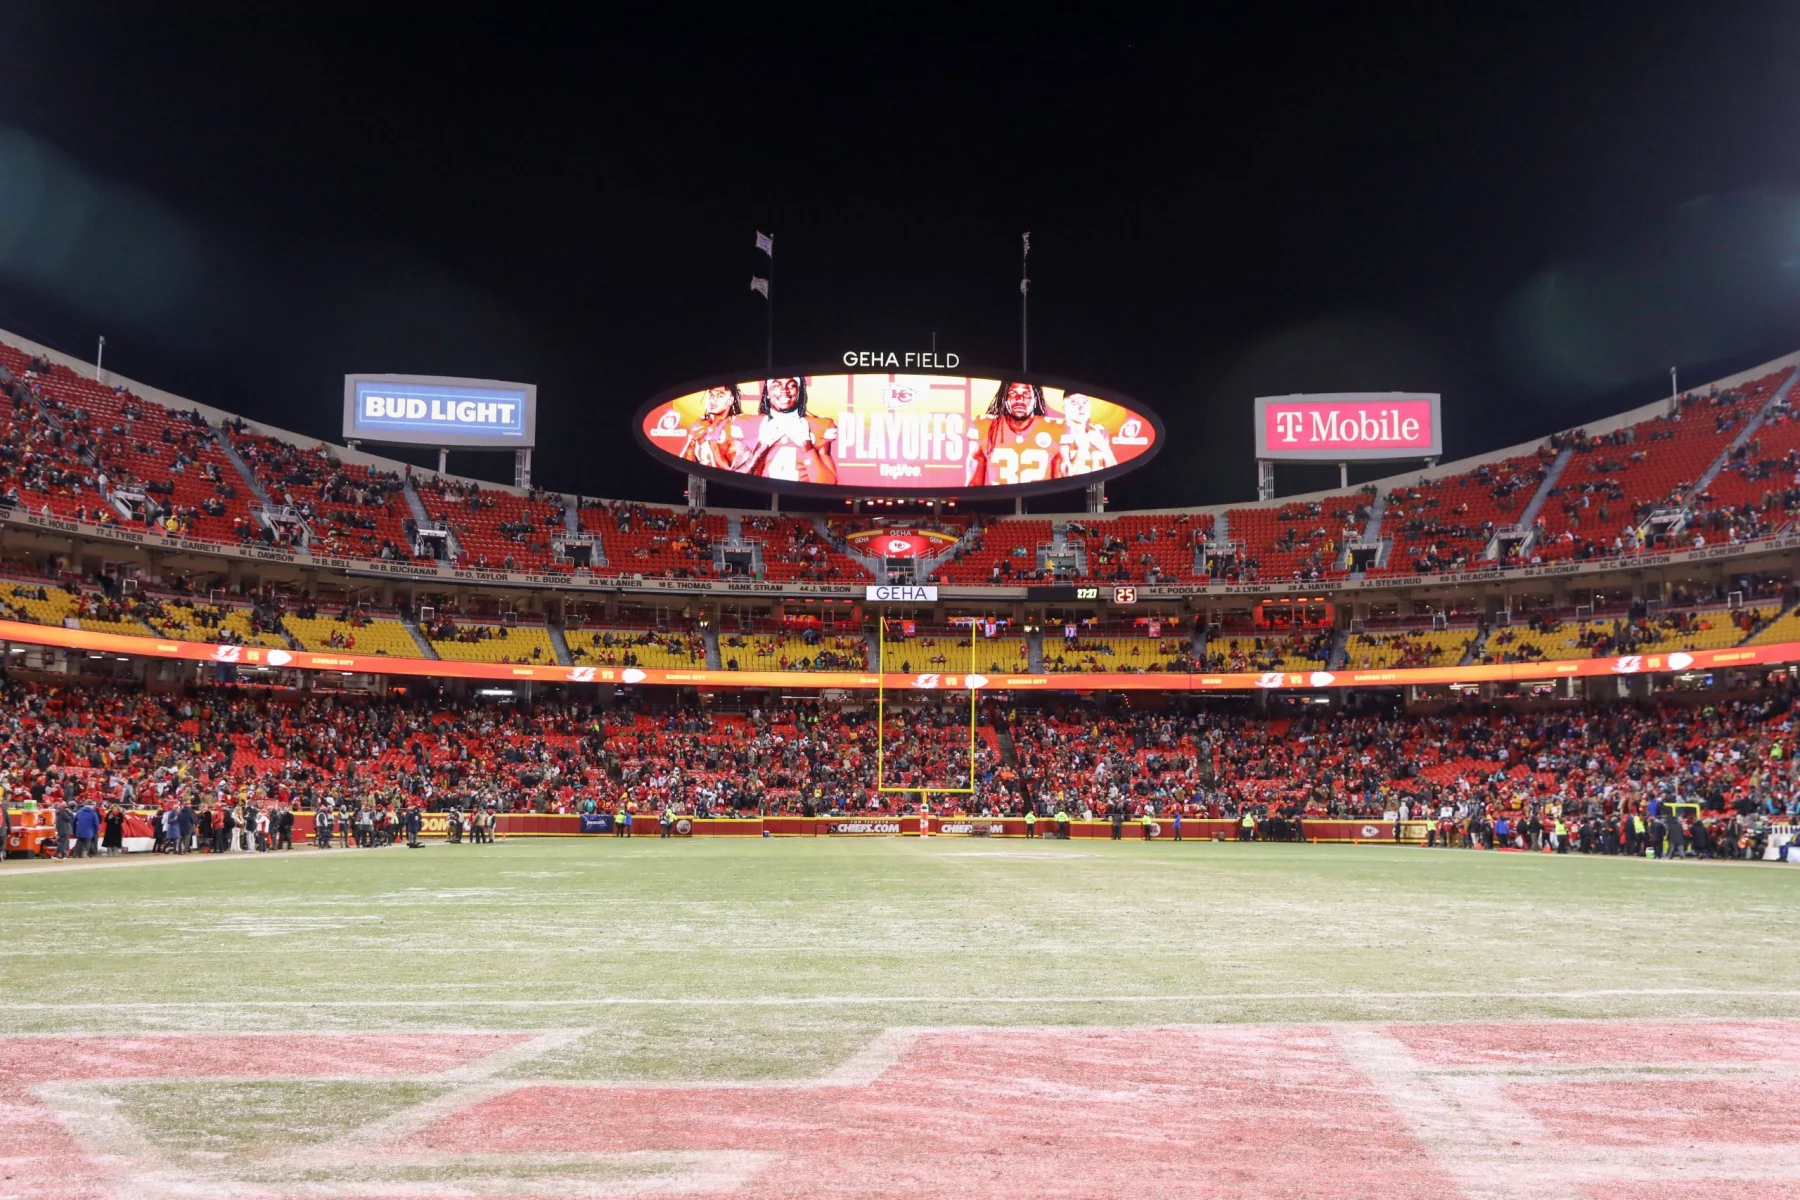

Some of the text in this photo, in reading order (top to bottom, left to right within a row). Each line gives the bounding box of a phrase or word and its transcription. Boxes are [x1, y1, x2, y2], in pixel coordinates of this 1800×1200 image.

[843, 351, 960, 368] GEHA FIELD
[366, 396, 427, 419] BUD
[1309, 410, 1420, 442] Mobile
[838, 412, 963, 461] PLAYOFFS
[991, 448, 1049, 485] 32
[49, 520, 78, 531] HOLUB
[114, 531, 143, 543] TYRER
[181, 541, 222, 553] GARRETT
[1709, 545, 1746, 557] CHERRY
[257, 551, 294, 562] DAWSON
[1619, 556, 1670, 568] McCLINTON
[331, 560, 352, 568] BELL
[390, 565, 438, 576] BUCHANAN
[1544, 565, 1580, 575] RUDNAY
[476, 572, 508, 581] TAYLOR
[1461, 571, 1506, 581] HEADRICK
[1375, 578, 1422, 587] STENERUD
[876, 586, 928, 600] GEHA
[1117, 588, 1134, 602] 25
[247, 651, 260, 661] VS
[1647, 658, 1661, 668] VS
[602, 671, 614, 680] VS
[1290, 675, 1303, 684] VS
[945, 677, 958, 686] VS
[838, 824, 899, 832] CHIEFS.COM
[10, 837, 20, 846] G
